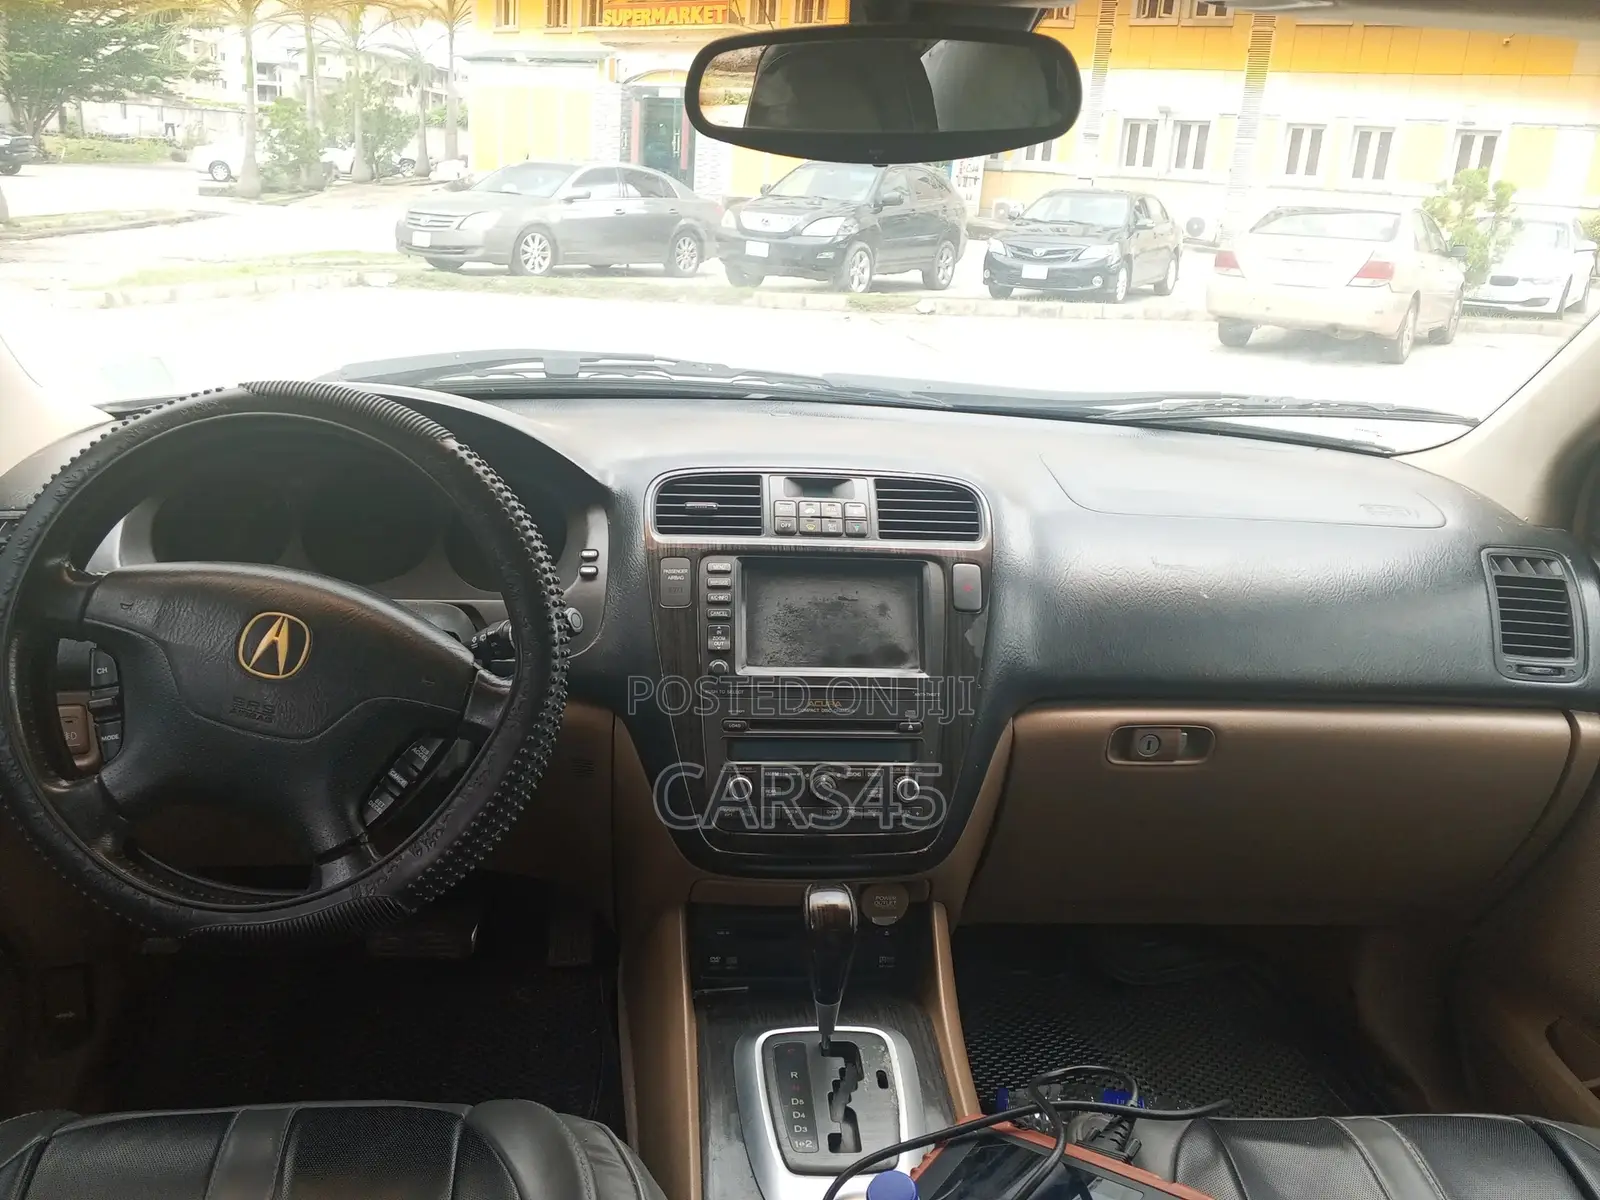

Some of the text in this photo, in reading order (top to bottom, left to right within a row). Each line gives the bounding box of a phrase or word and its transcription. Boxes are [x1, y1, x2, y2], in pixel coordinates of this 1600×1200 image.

[603, 5, 727, 26] SUPERMARKET
[96, 666, 108, 675] CH
[790, 1071, 799, 1079] R
[790, 1097, 805, 1106] D5
[792, 1111, 806, 1119] D4
[793, 1124, 808, 1133] D3
